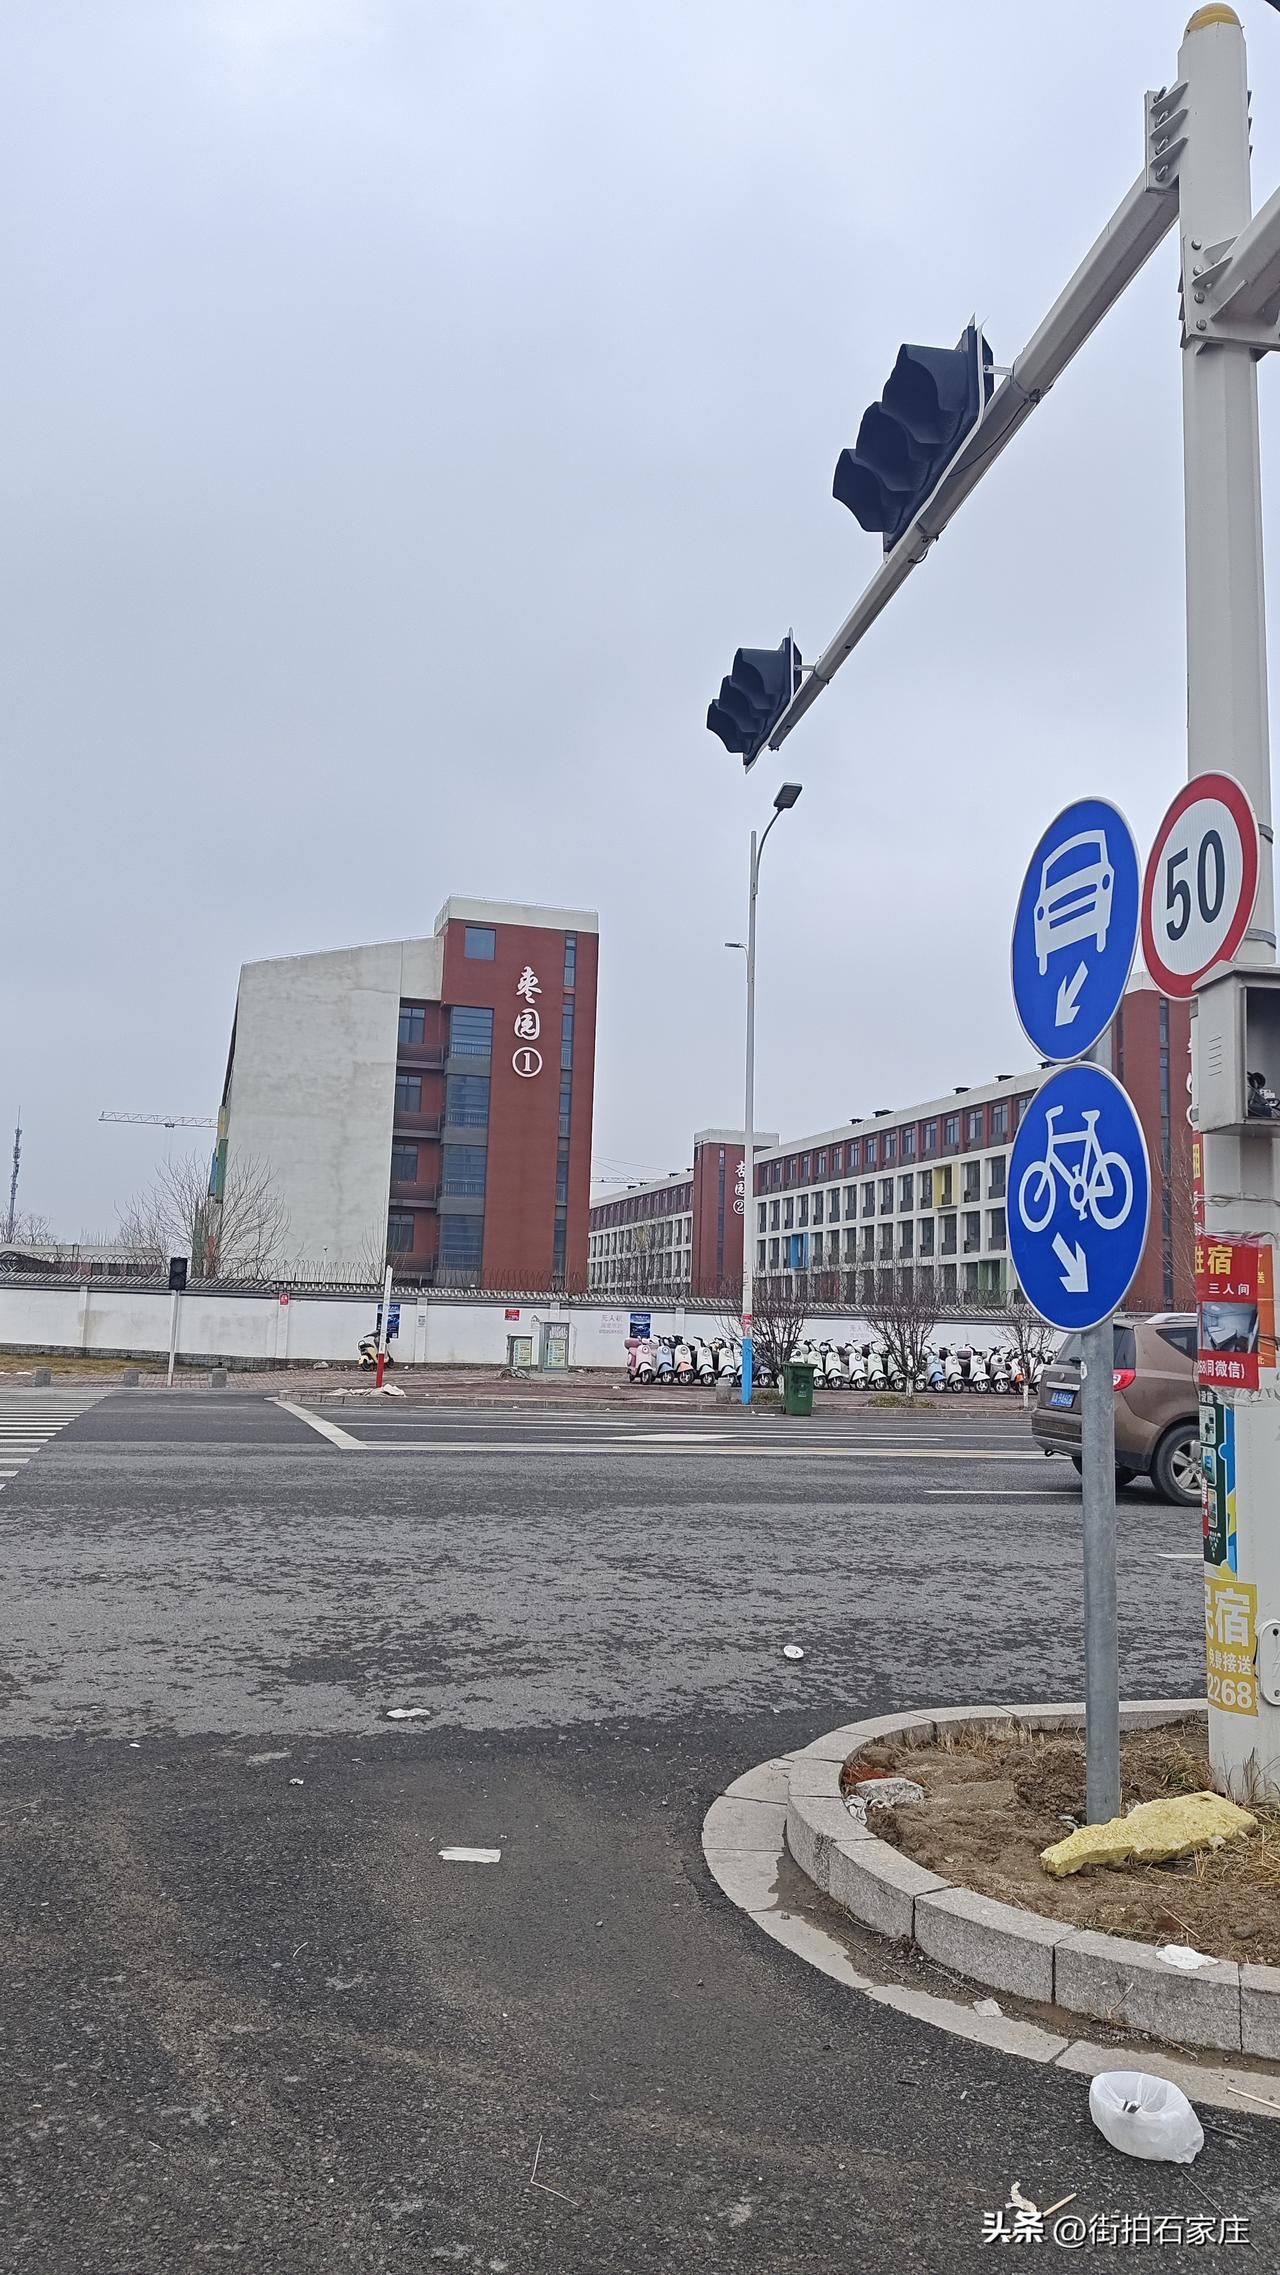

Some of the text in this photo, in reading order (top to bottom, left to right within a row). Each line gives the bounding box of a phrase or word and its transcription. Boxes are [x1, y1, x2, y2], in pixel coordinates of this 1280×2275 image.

[1166, 829, 1226, 942] 50
[1208, 1282, 1250, 1296] 三人间
[1209, 1647, 1252, 1676] 免费接送
[1207, 1672, 1253, 1709] 2268
